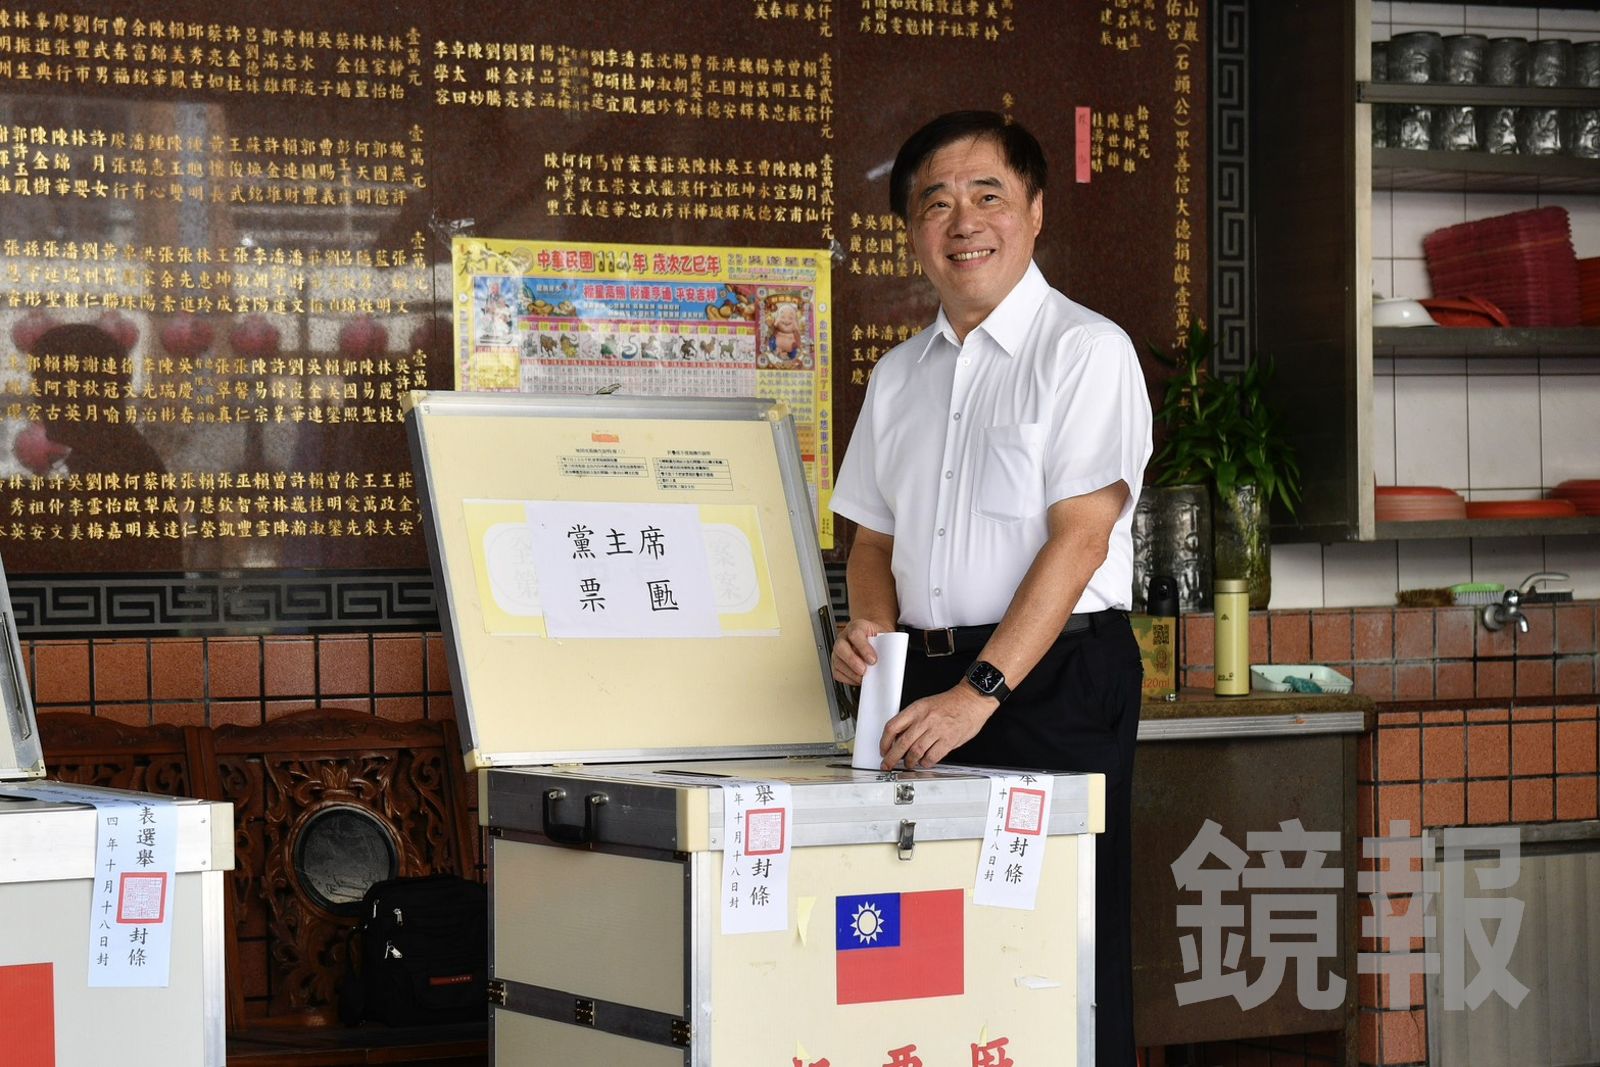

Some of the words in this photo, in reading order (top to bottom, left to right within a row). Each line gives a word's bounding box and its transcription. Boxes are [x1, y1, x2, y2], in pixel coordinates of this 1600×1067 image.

[406, 27, 423, 87] 壹萬元
[408, 124, 426, 189] 壹萬元
[566, 524, 667, 560] 黨主席
